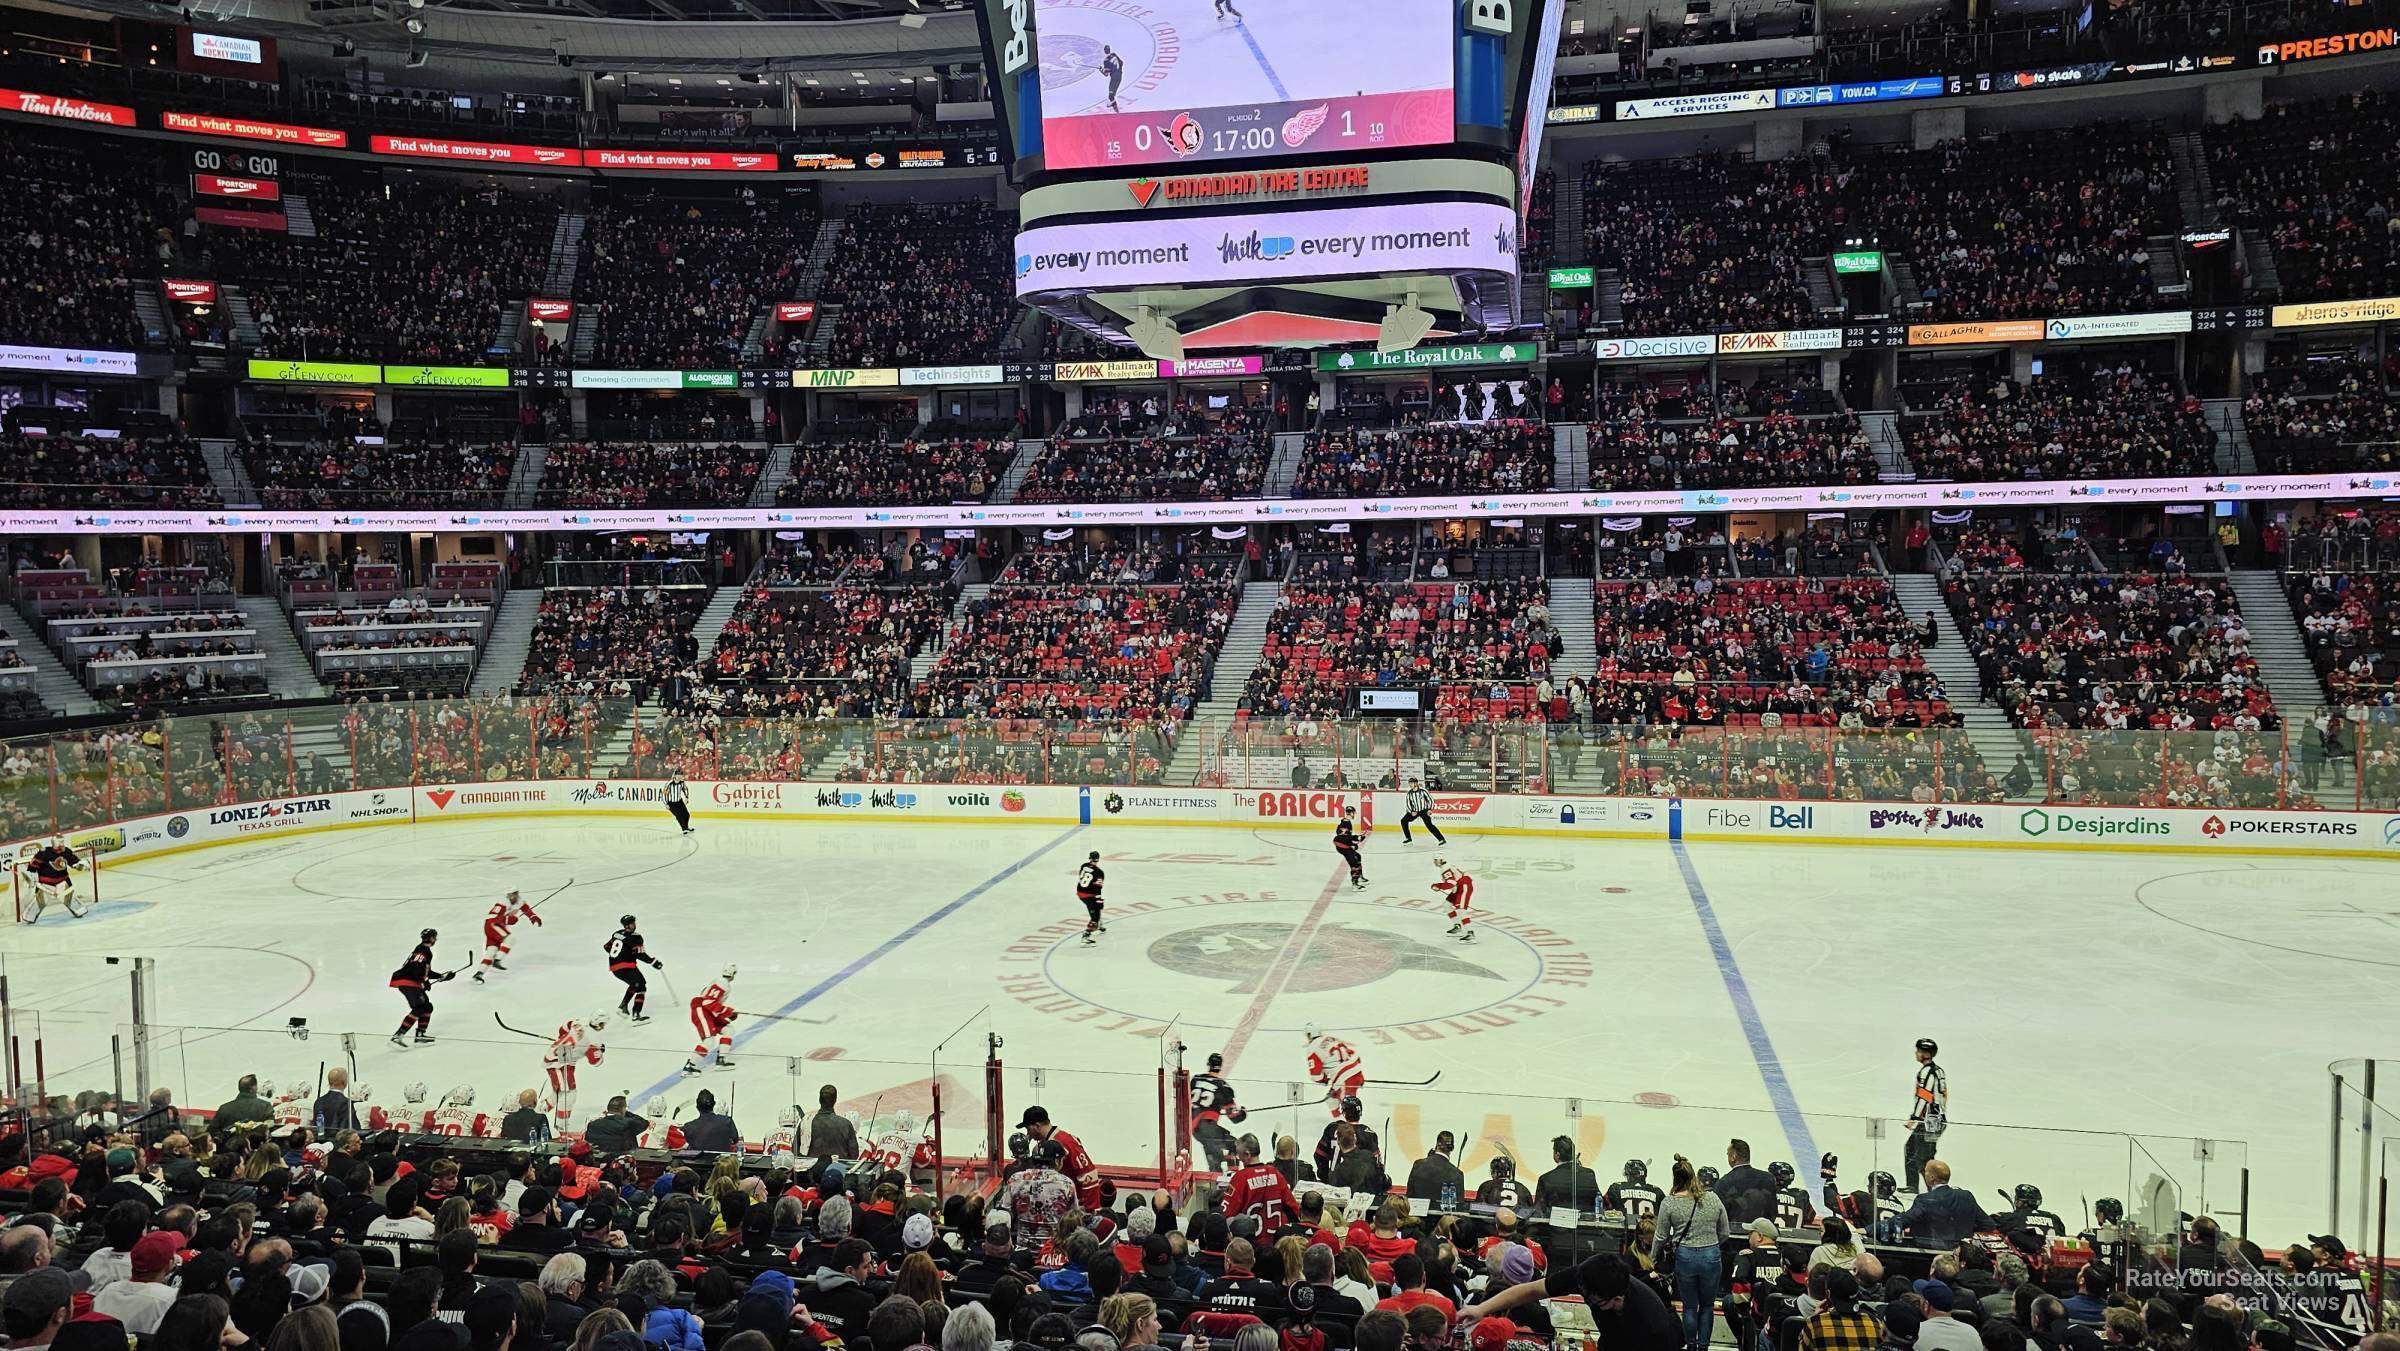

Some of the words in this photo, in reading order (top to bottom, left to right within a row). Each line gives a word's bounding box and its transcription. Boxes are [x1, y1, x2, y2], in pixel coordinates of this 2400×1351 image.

[2281, 28, 2393, 61] PRESTON
[2048, 69, 2081, 83] skate
[1841, 86, 1877, 98] YOW.CA
[1951, 81, 1961, 93] 15
[1979, 79, 1990, 91] 10
[1653, 97, 1696, 107] ACCESS
[1700, 93, 1750, 103] RIGGING
[19, 93, 50, 113] Tim
[53, 97, 114, 123] Hortons
[1673, 103, 1729, 113] SERVICES
[168, 111, 197, 127] Find
[200, 117, 232, 131] what
[235, 122, 273, 136] moves
[275, 127, 298, 139] you
[1341, 110, 1356, 136] 1
[1370, 122, 1384, 135] 10
[1135, 125, 1152, 151] 0
[1213, 127, 1275, 151] 17:00
[389, 139, 417, 151] Find
[419, 143, 449, 154] what
[451, 146, 488, 156] moves
[489, 148, 511, 159] you
[1107, 141, 1121, 153] 15
[195, 151, 221, 170] GO
[248, 156, 278, 176] GO!
[600, 152, 626, 165] Find
[627, 153, 656, 165] what
[656, 155, 690, 166] moves
[691, 156, 711, 168] you
[966, 152, 976, 164] 15
[988, 151, 998, 163] 10
[1163, 174, 1256, 200] CANADIAN
[1260, 171, 1299, 195] TIRE
[1303, 167, 1369, 191] CENTRE
[1301, 236, 1366, 257] every
[1371, 227, 1471, 252] moment
[1035, 251, 1091, 272] every
[1096, 243, 1189, 267] moment
[2245, 309, 2264, 317] 325
[2245, 319, 2264, 327] 225
[1847, 328, 1864, 336] 323
[1886, 326, 1904, 334] 324
[1922, 326, 1984, 340] GALLAGHER
[1721, 334, 1778, 350] RE/MAX
[1782, 330, 1840, 341] Hallmark
[1782, 341, 1810, 351] Realty
[1812, 339, 1840, 349] Group
[1847, 339, 1864, 347] 223
[1886, 337, 1903, 345] 224
[1624, 338, 1708, 358] Decisive
[7, 353, 51, 362] moment
[1370, 351, 1400, 366] The
[1403, 348, 1448, 367] Royal
[1450, 345, 1483, 361] Oak
[1057, 363, 1104, 379] RE/MAX
[1108, 361, 1155, 371] Hallmark
[1188, 358, 1246, 370] MAGENTA
[514, 369, 528, 377] 318
[554, 370, 567, 378] 319
[688, 373, 733, 382] ALGONQUIN
[741, 370, 754, 378] 319
[774, 370, 788, 378] 320
[810, 370, 855, 386] MNP
[1108, 371, 1131, 379] Realty
[1132, 370, 1155, 379] Group
[514, 379, 528, 387] 218
[554, 380, 568, 388] 219
[742, 380, 755, 388] 219
[775, 380, 789, 388] 220
[2245, 483, 2276, 494] every
[2280, 481, 2331, 491] moment
[1853, 493, 1882, 502] every
[1884, 490, 1927, 499] moment
[1393, 505, 1418, 514] every
[1420, 503, 1458, 512] moment
[367, 518, 394, 526] every
[396, 516, 437, 525] moment
[987, 512, 1010, 521] every
[1011, 511, 1045, 519] moment
[460, 790, 520, 805] CANADIAN
[523, 790, 546, 802] TIRE
[571, 787, 614, 805] Molson
[712, 782, 782, 804] Gabriel
[948, 793, 990, 806] voilà
[734, 801, 782, 809] PIZZA
[1129, 797, 1169, 807] PLANET
[1172, 798, 1217, 808] FITNESS
[1232, 793, 1256, 807] The
[1258, 792, 1346, 818] BRICK
[210, 807, 259, 825] LONE
[283, 799, 332, 815] STAR
[1708, 808, 1751, 828] Fibe
[1770, 805, 1813, 829] Bell
[238, 819, 272, 832] TEXAS
[274, 815, 304, 827] GRILL
[1870, 809, 1923, 829] Booster
[1940, 809, 1984, 831] Juice
[2057, 815, 2170, 837] Desjardins
[2230, 820, 2358, 836] POKERSTARS
[1502, 1182, 1516, 1191] ZUB
[1500, 1190, 1518, 1207] 2
